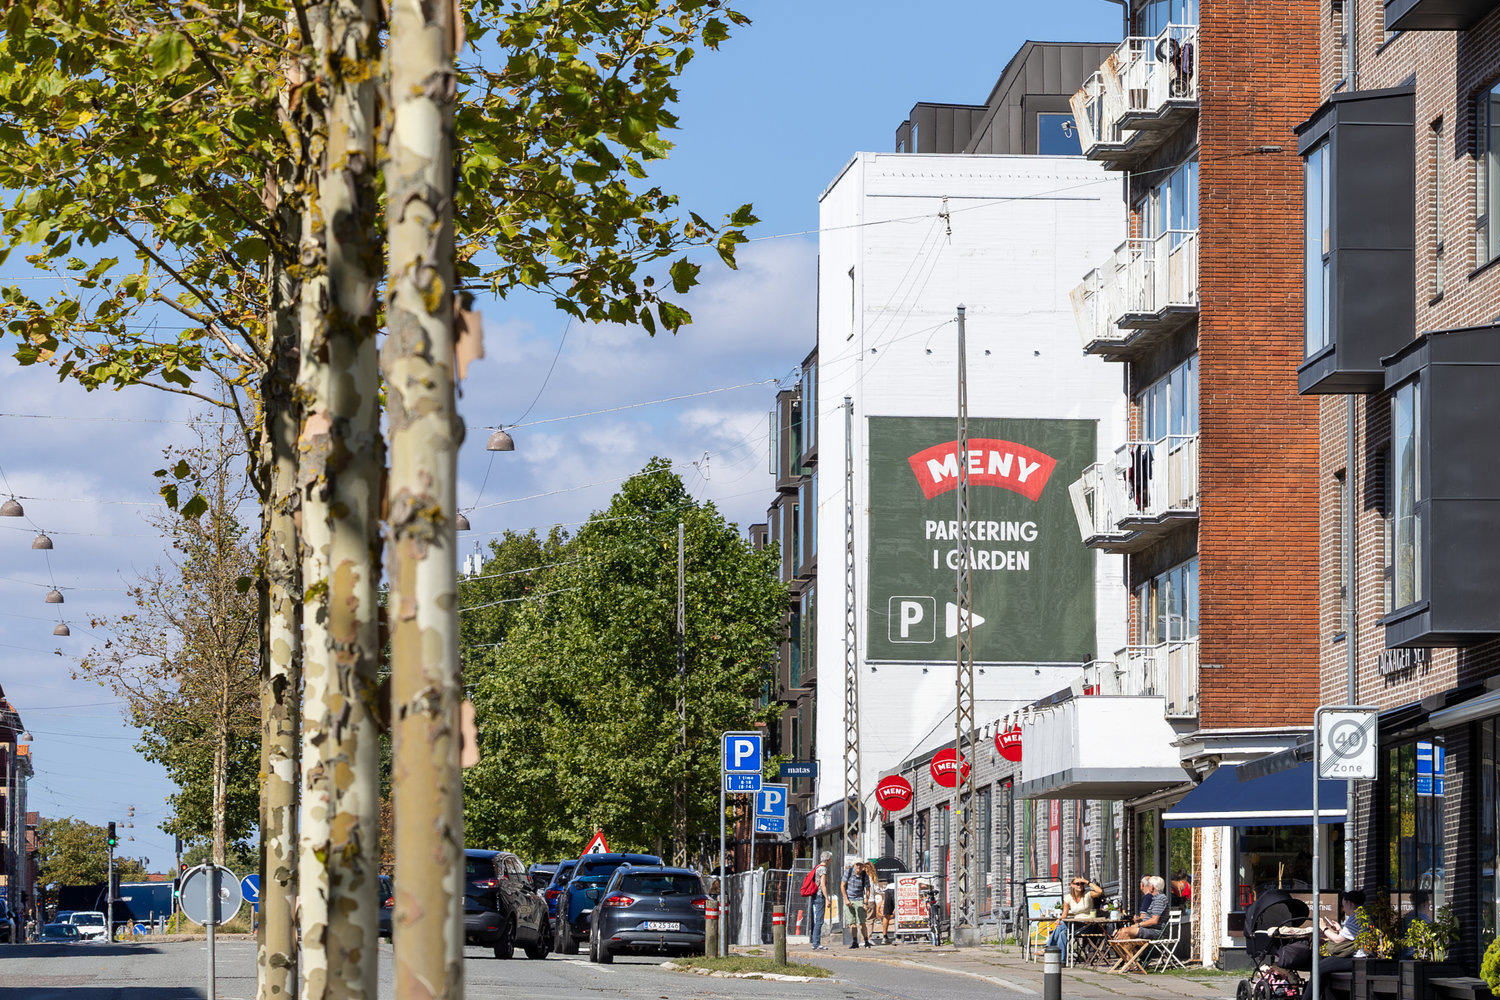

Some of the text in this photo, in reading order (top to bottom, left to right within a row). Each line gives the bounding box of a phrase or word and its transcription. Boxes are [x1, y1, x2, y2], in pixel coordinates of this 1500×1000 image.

[926, 450, 1041, 483] MENY
[925, 520, 1038, 541] PARKERING
[933, 547, 1030, 570] I GÅRDEN
[900, 601, 924, 638] P
[1003, 735, 1023, 743] MEN
[1335, 731, 1360, 747] 40
[734, 740, 754, 767] P
[1333, 763, 1362, 772] Zone
[762, 790, 782, 812] P
[883, 787, 907, 796] MENY
